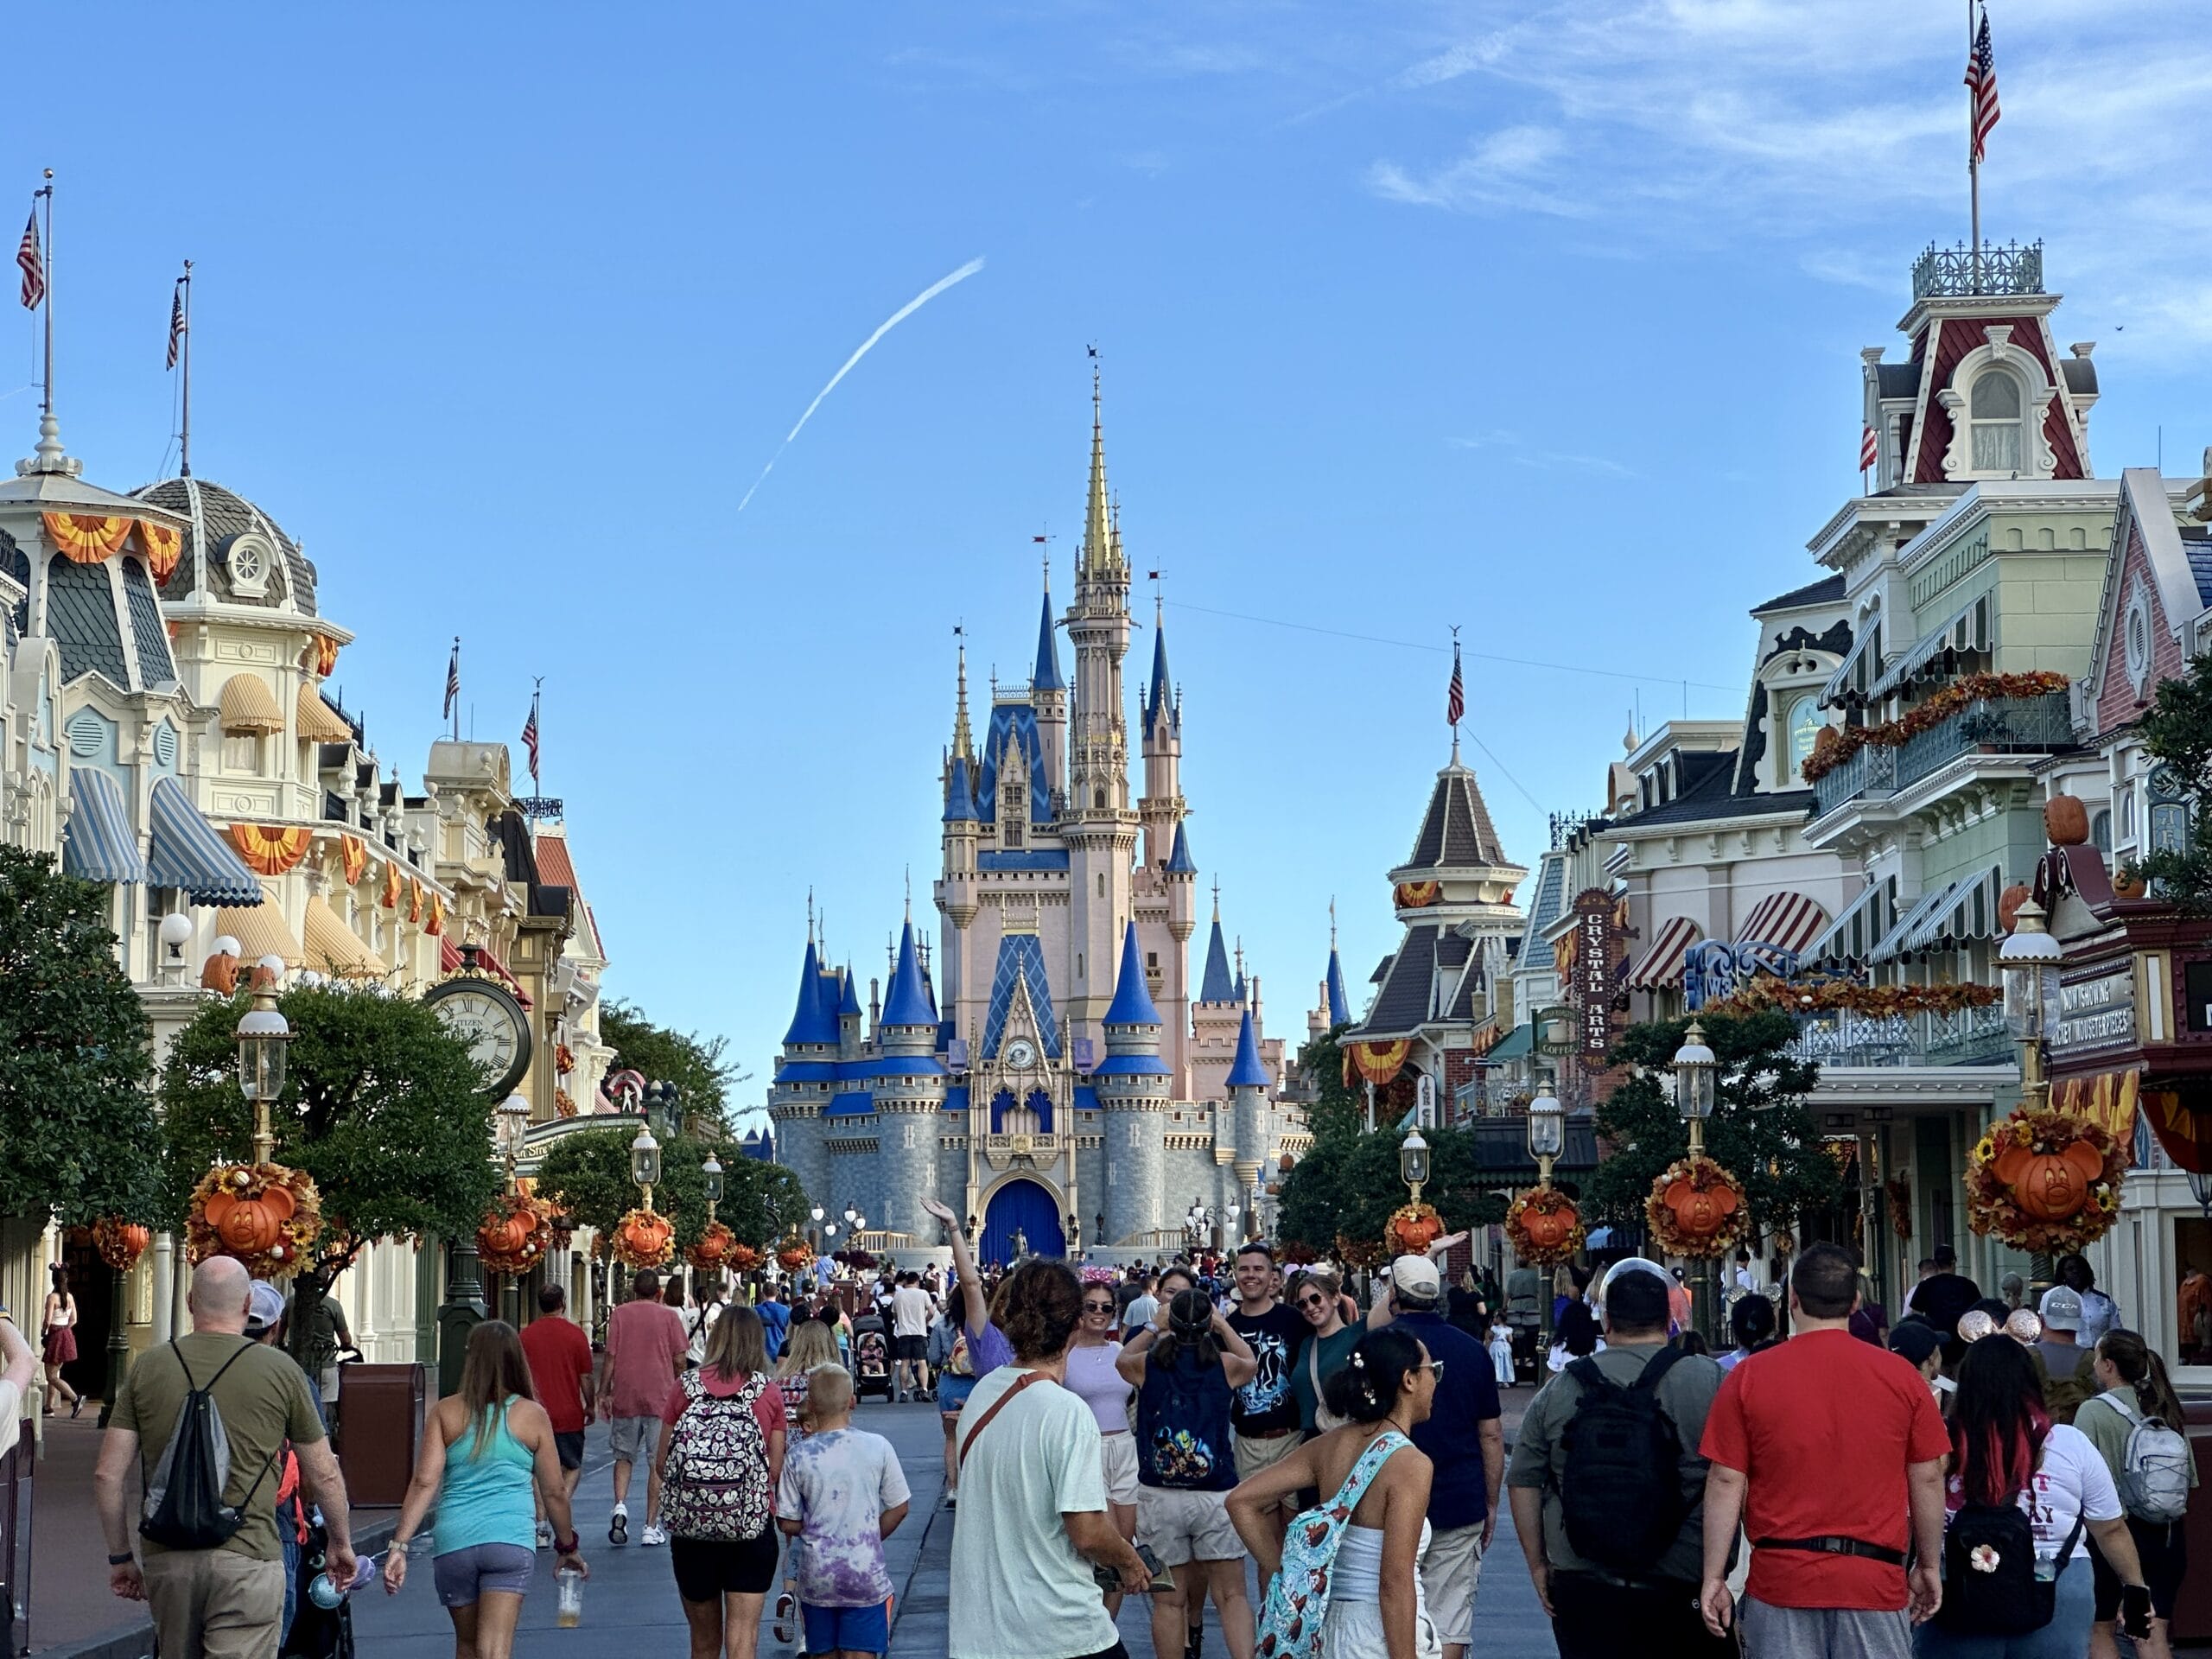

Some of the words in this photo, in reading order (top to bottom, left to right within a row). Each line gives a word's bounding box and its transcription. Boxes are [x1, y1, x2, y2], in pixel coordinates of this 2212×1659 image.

[1586, 914, 1604, 992] CRYSTAL
[2063, 988, 2078, 1011] NOW
[2081, 981, 2110, 1007] SHOWING
[1588, 1004, 1605, 1049] ARTS
[1542, 1044, 1575, 1054] COFFEE
